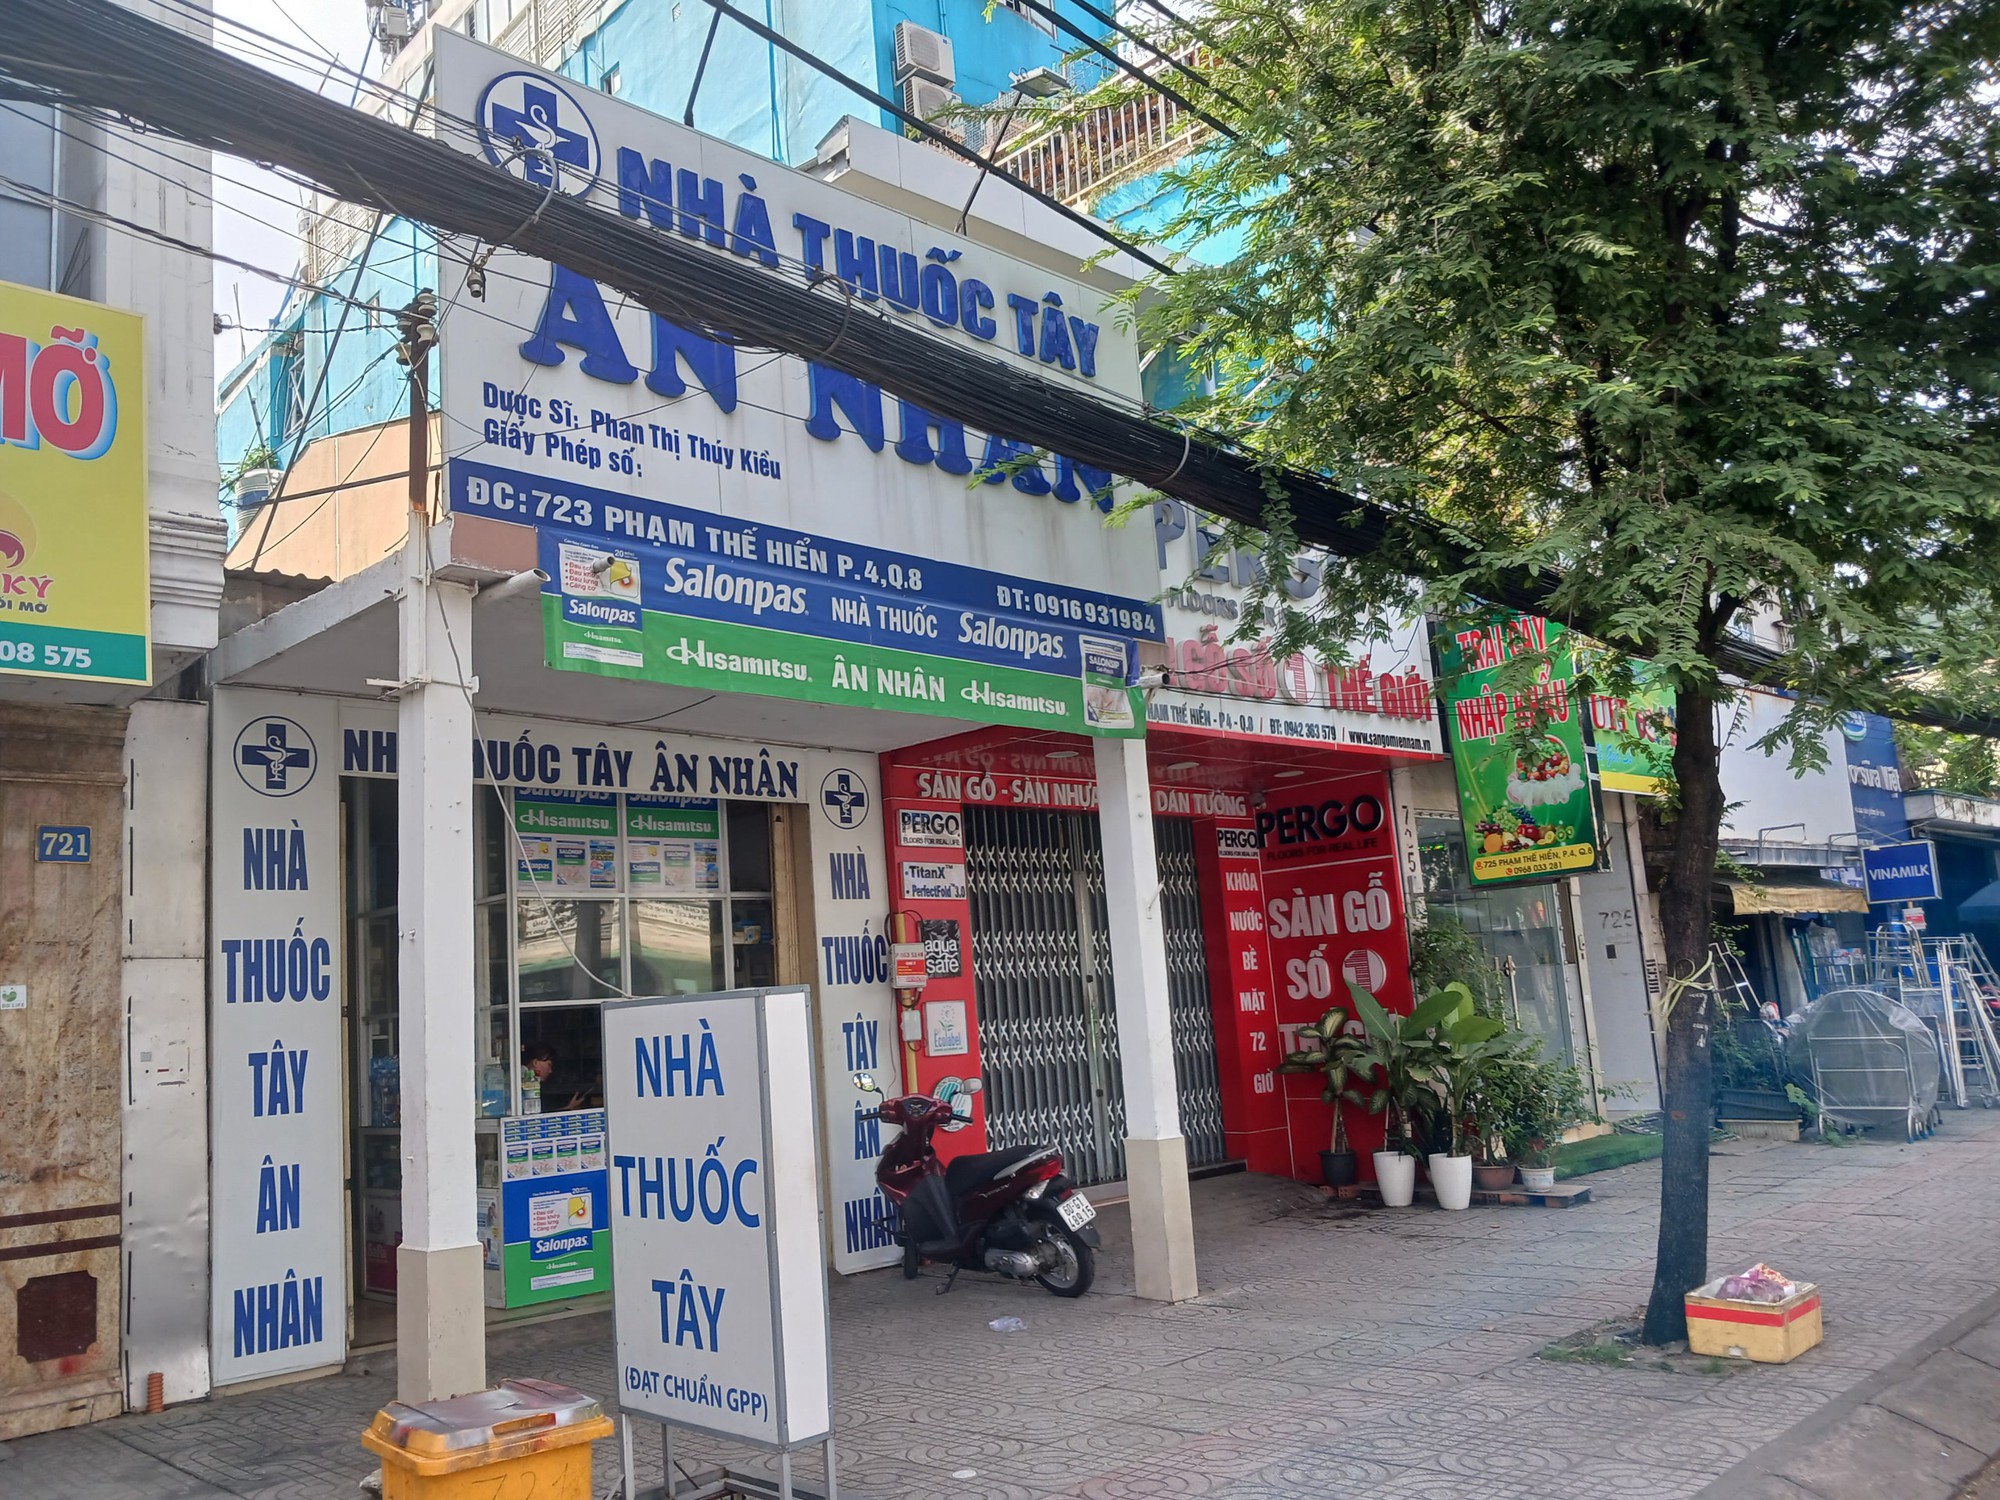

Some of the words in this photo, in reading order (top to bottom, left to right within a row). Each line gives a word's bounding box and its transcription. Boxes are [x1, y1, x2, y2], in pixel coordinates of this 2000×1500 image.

[617, 146, 780, 268] NHÀ
[793, 212, 997, 341] THUỐC
[1007, 290, 1100, 378] TÂY
[483, 382, 541, 419] Dược
[590, 409, 644, 445] Phan
[648, 424, 680, 461] Thị
[687, 434, 734, 470] Thúy
[740, 449, 781, 480] Kiều
[483, 418, 535, 456] Giấy
[545, 432, 601, 469] Phép
[608, 447, 643, 478] số:
[604, 505, 694, 548] PHẠM
[705, 527, 757, 560] THẾ
[766, 537, 828, 574] HIỂN
[569, 600, 635, 623] Salonpas
[664, 557, 807, 616] Salonpas
[831, 596, 871, 628] NHÀ
[876, 604, 938, 639] THUỐC
[958, 612, 1064, 660] Salonpas
[44, 644, 92, 668] 575
[666, 637, 808, 681] Hisamitsu
[831, 654, 868, 692] ÂN
[877, 666, 945, 702] NHÂN
[960, 679, 1067, 717] Hisamitsu
[1379, 664, 1433, 723] GIỚI
[1456, 684, 1508, 745] NHẬP
[1170, 702, 1188, 724] THẾ
[1284, 720, 1303, 737] 0942
[1306, 723, 1320, 739] 363
[1321, 725, 1337, 741] 579
[1349, 730, 1431, 752] www.sangomiennam.vn
[343, 729, 397, 774] NH
[472, 730, 561, 784] UỐC
[572, 743, 633, 788] TÂY
[651, 740, 699, 793] ÂN
[709, 748, 798, 799] NHÂN
[519, 809, 610, 830] Hisamitsu
[918, 771, 961, 798] SÀN
[966, 772, 996, 801] GỖ
[1012, 777, 1049, 804] SÀN
[1192, 789, 1247, 815] TƯỜNG
[42, 832, 89, 856] 721
[630, 815, 713, 833] Hisamitsu
[1217, 829, 1257, 848] PERGO
[1256, 795, 1385, 850] PERGO
[1357, 838, 1378, 848] LIFE
[242, 819, 309, 891] NHÀ
[829, 845, 870, 900] NHÀ
[1225, 868, 1259, 891] KHÓA
[1484, 859, 1497, 868] 725
[1514, 866, 1532, 875] 0968
[1533, 863, 1548, 872] 033
[1549, 862, 1562, 870] 281
[1869, 864, 1931, 881] VINAMILK
[1229, 906, 1263, 931] NƯỚC
[1268, 888, 1338, 939] SÀN
[1343, 871, 1392, 933] GỖ
[222, 917, 331, 1004] THUỐC
[821, 919, 888, 985] THUỐC
[925, 938, 958, 957] aqua
[926, 957, 959, 975] safe
[1286, 944, 1332, 999] SỐ
[1239, 987, 1265, 1015] MẶT
[634, 1018, 725, 1098] NHÀ
[842, 1012, 878, 1072] TÂY
[1250, 1032, 1266, 1051] 72
[248, 1039, 309, 1117] TÂY
[1253, 1068, 1274, 1094] GIỜ
[854, 1099, 883, 1161] ÂN
[256, 1155, 300, 1233] ÂN
[613, 1136, 761, 1228] THUỐC
[1068, 1205, 1094, 1228] 489.15
[535, 1235, 588, 1254] Salonpas
[233, 1268, 323, 1358] NHÂN
[651, 1268, 725, 1353] TÂY
[625, 1366, 661, 1399] (ĐẠT
[663, 1374, 722, 1409] CHUẨN
[726, 1388, 768, 1423] GPP)
